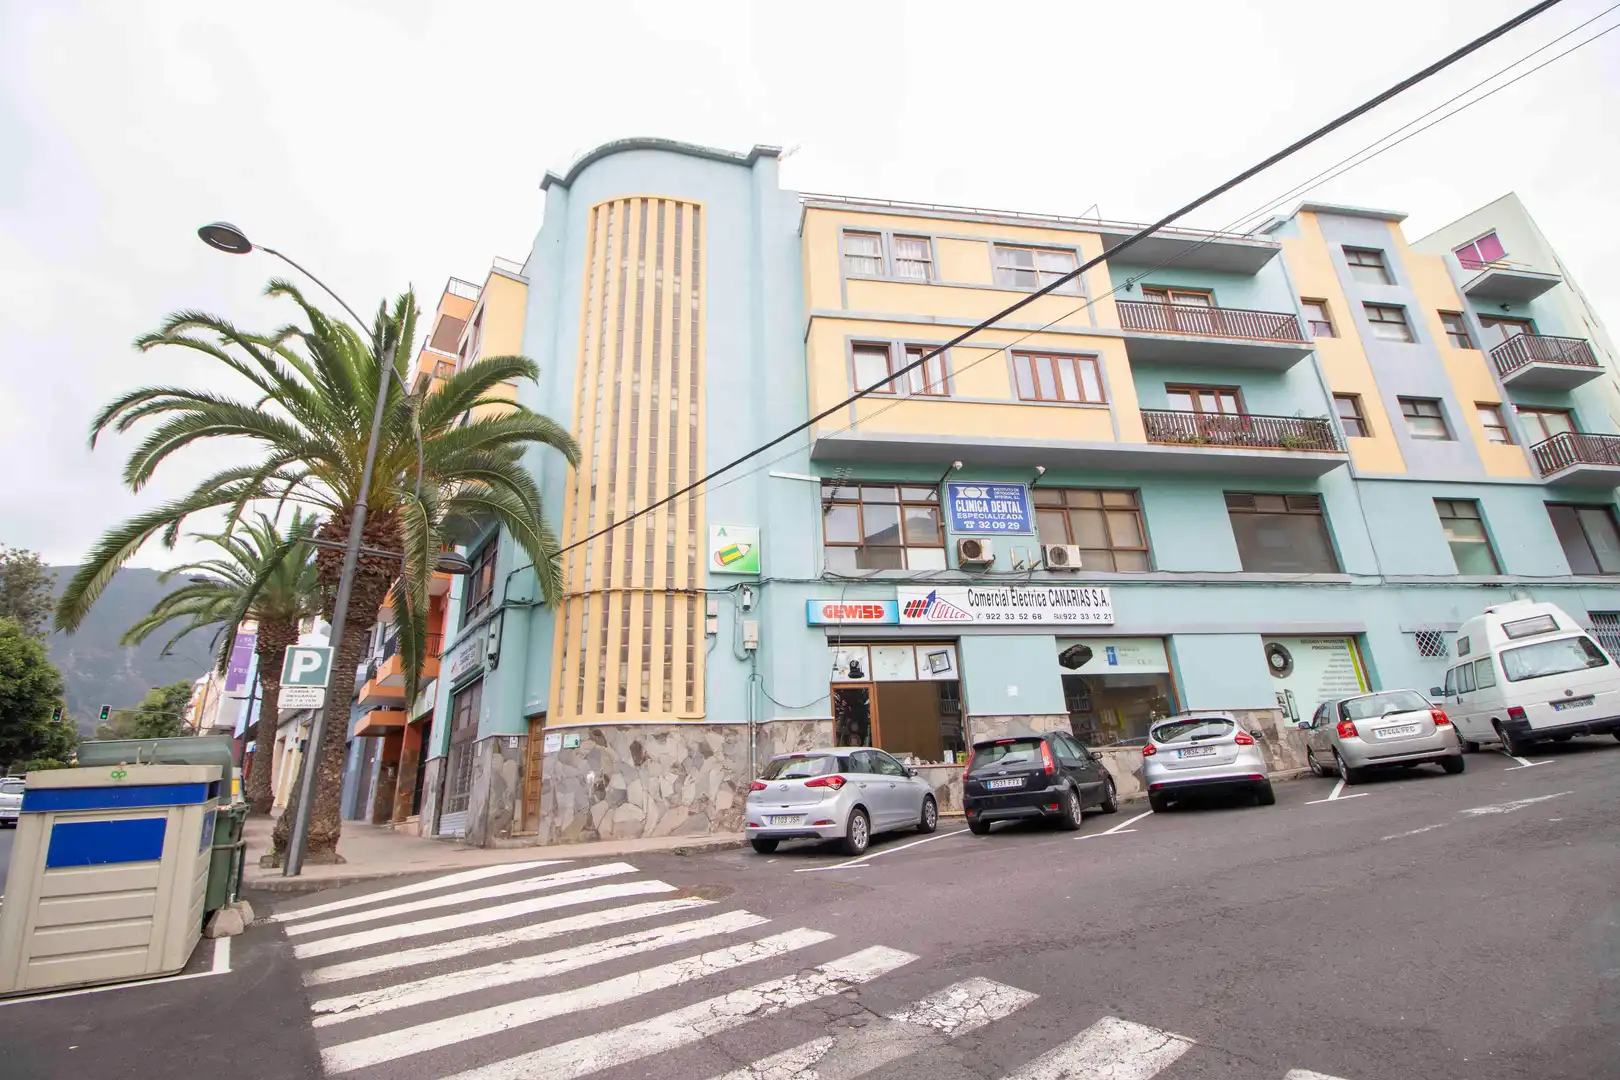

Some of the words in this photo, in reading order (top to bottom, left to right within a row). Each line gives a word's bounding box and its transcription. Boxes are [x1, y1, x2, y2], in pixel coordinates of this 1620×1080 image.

[956, 500, 989, 513] CLINICA
[991, 500, 1023, 513] DENTAL
[717, 527, 728, 537] A
[968, 589, 1010, 607] Comercial
[1049, 589, 1091, 607] CANARIAS
[1093, 589, 1110, 607] S.A.
[290, 650, 322, 682] P
